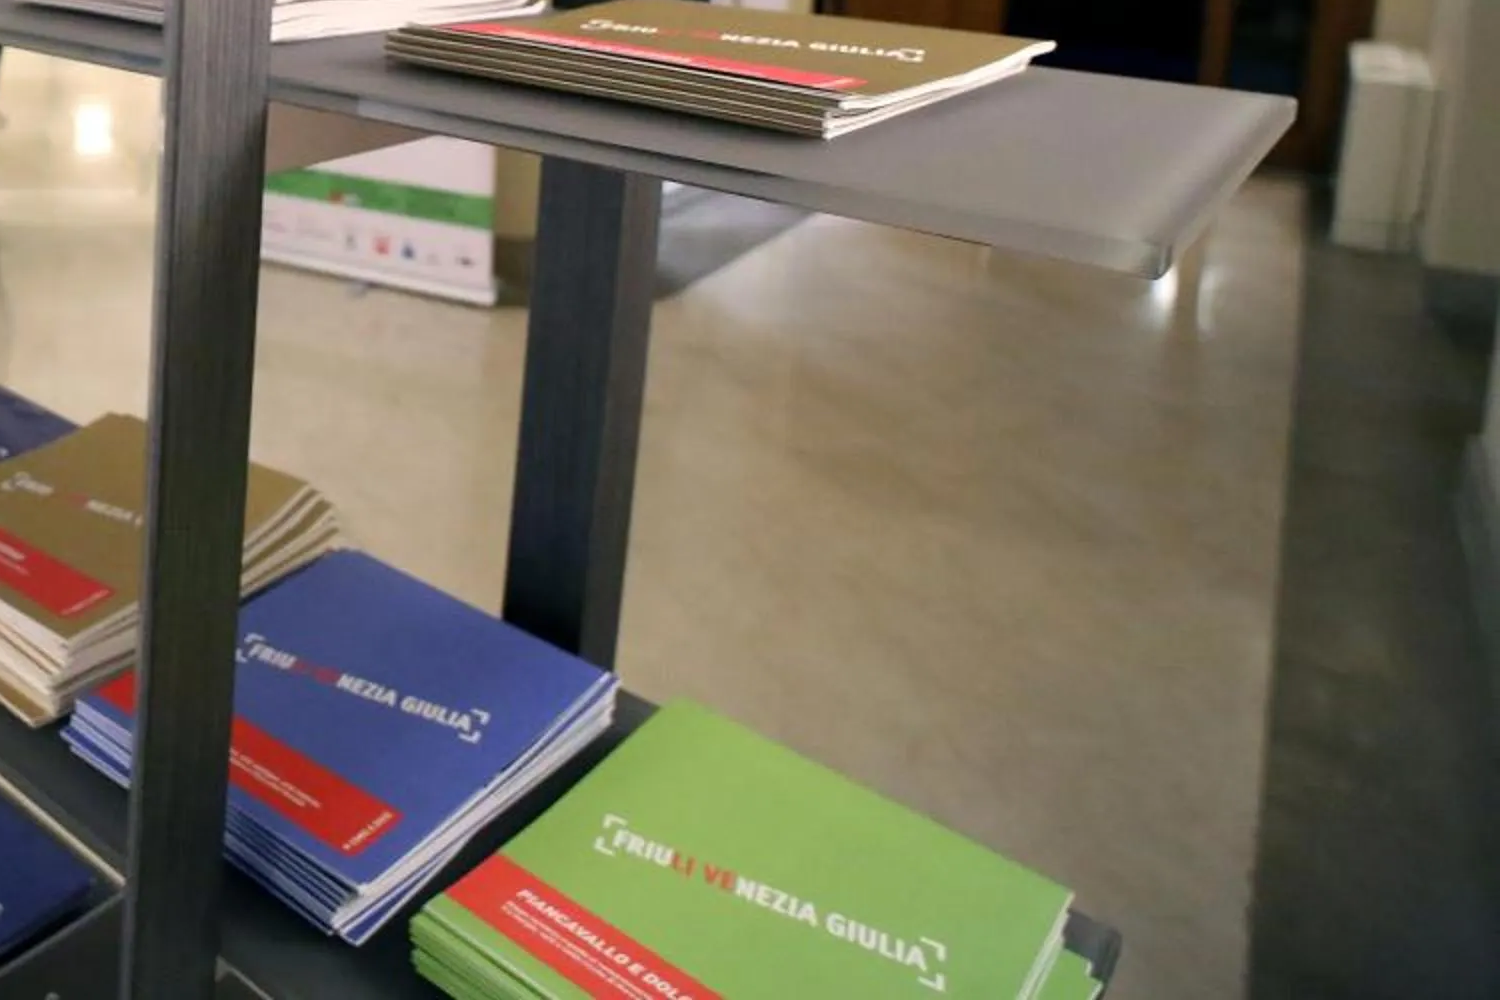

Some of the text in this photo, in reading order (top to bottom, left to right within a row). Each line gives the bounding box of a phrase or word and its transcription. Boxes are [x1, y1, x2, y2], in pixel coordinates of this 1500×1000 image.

[401, 695, 473, 732] GIULIA
[515, 888, 631, 965] PIANCAVALLO
[612, 828, 928, 972] FRIULI VENEZIA GIULIA
